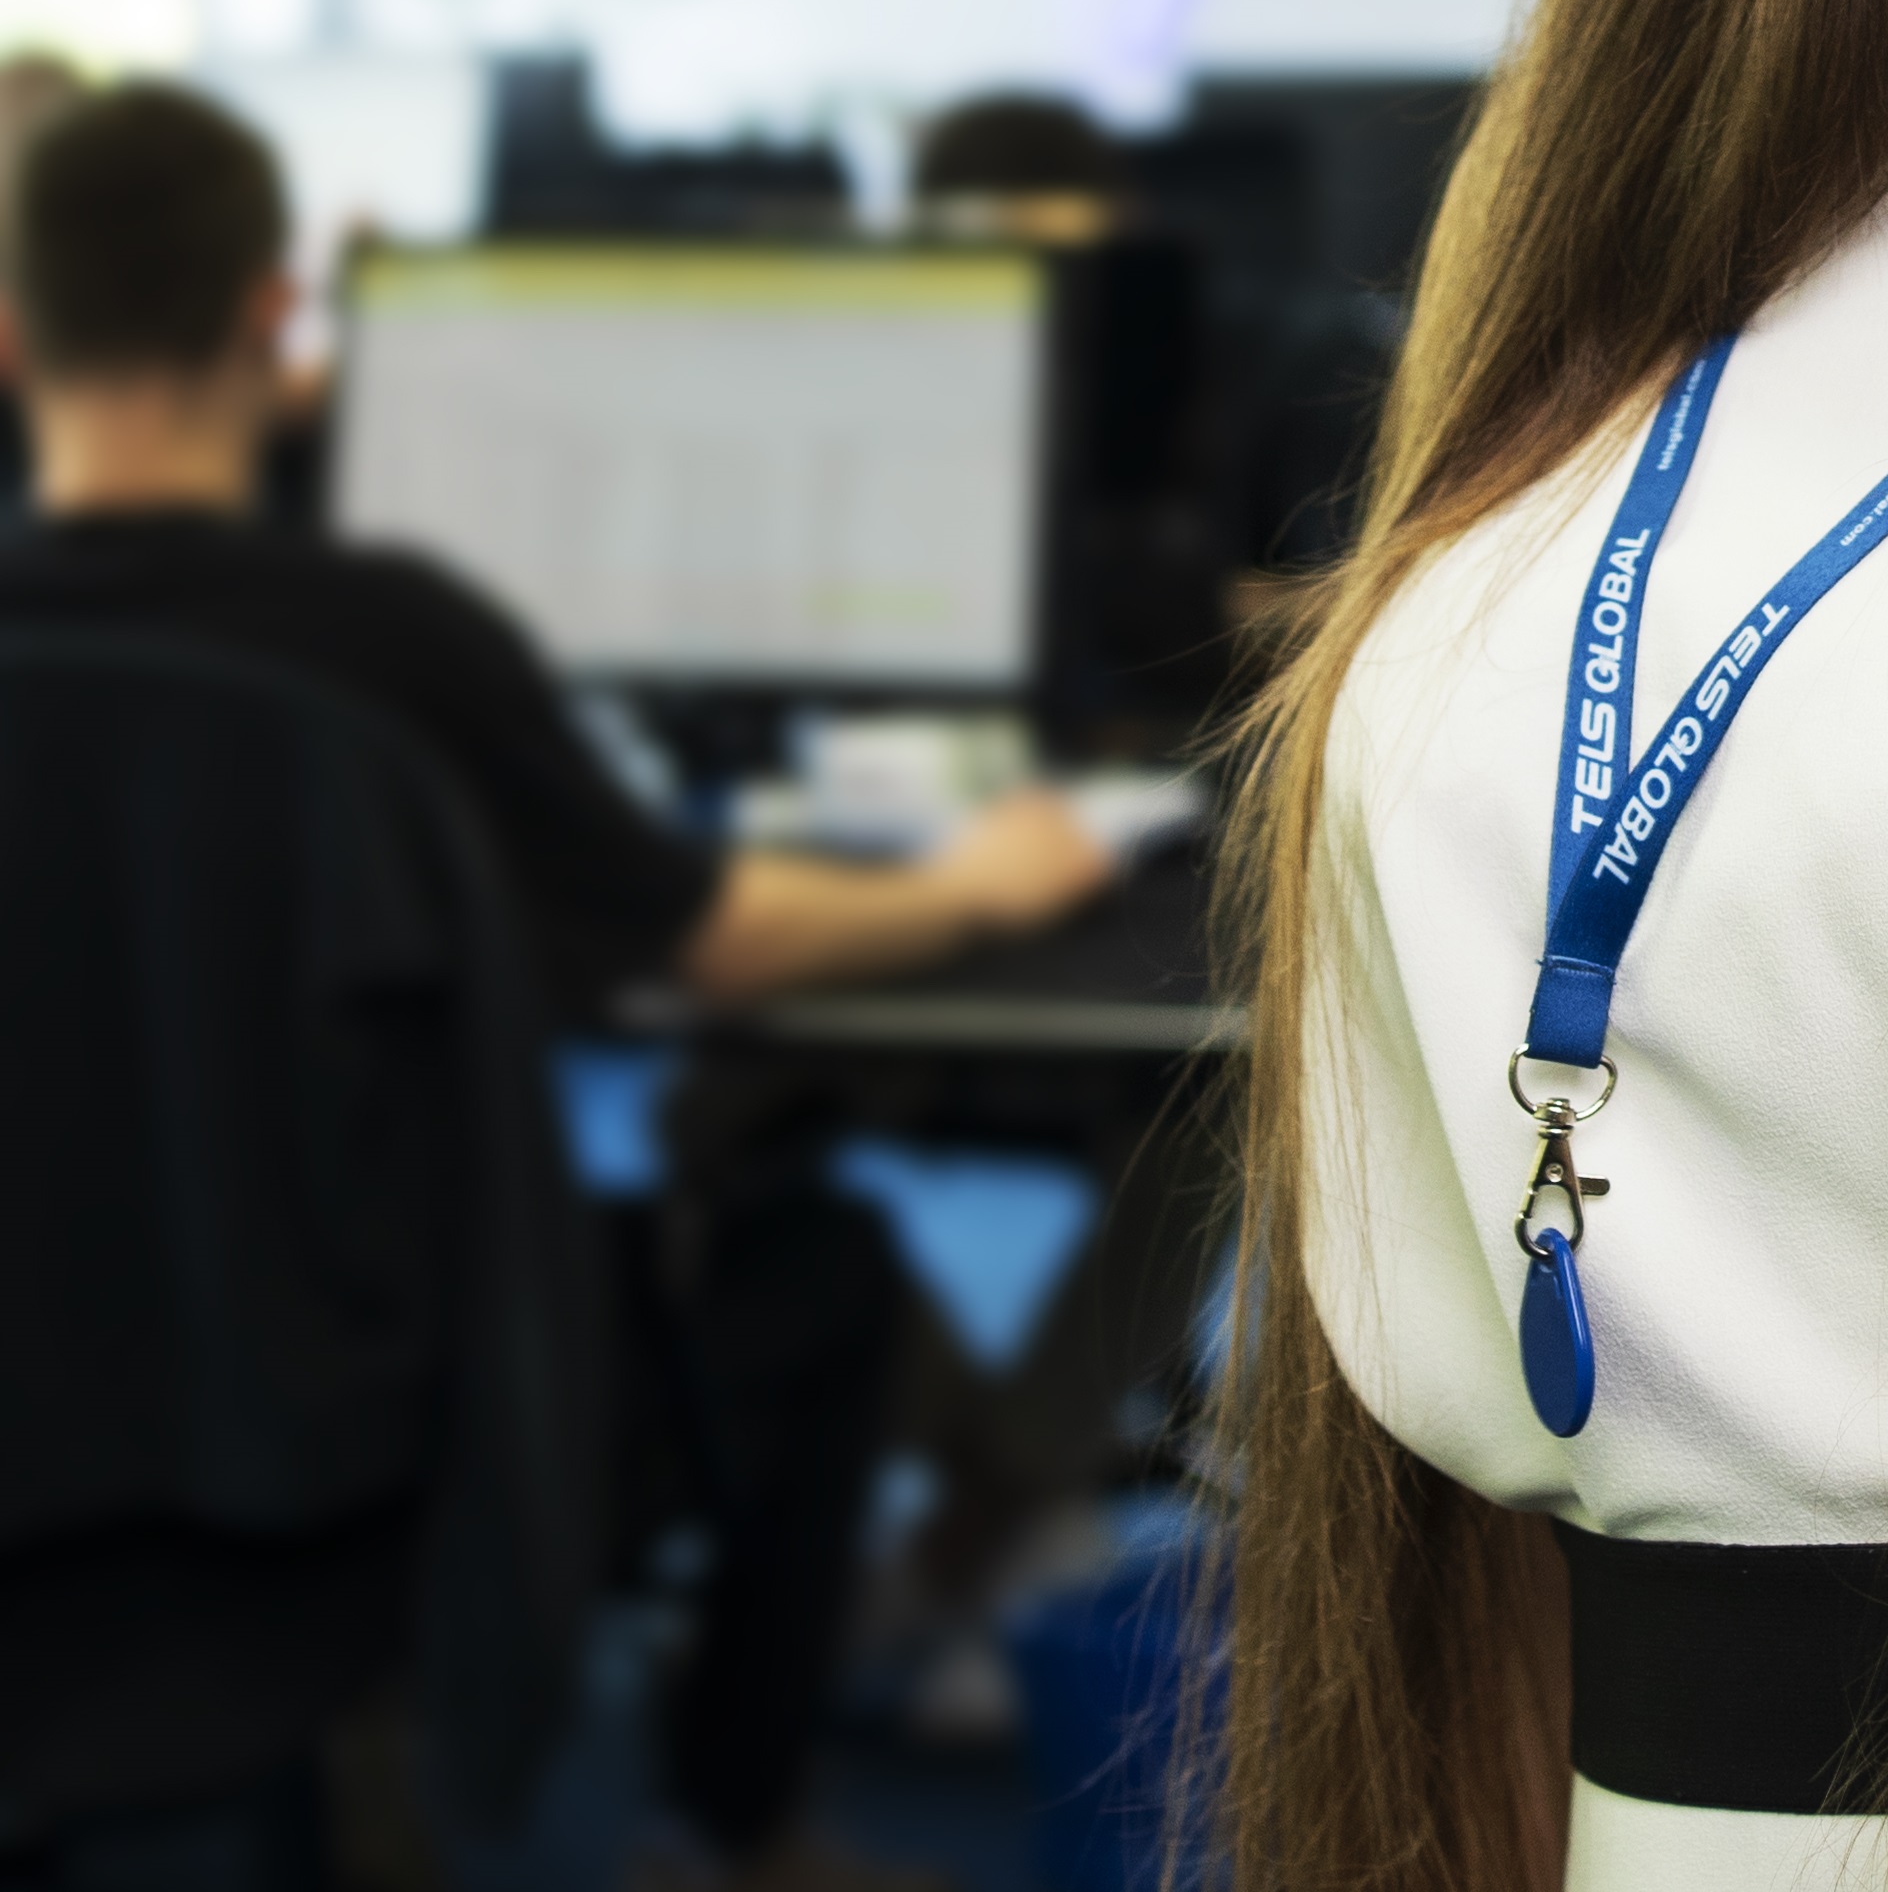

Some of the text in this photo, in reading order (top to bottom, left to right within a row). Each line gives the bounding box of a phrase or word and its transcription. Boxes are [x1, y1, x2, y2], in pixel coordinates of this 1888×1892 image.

[1571, 529, 1651, 834] TELS GLOBAL
[1593, 603, 1790, 883] TELS GLOBAL
